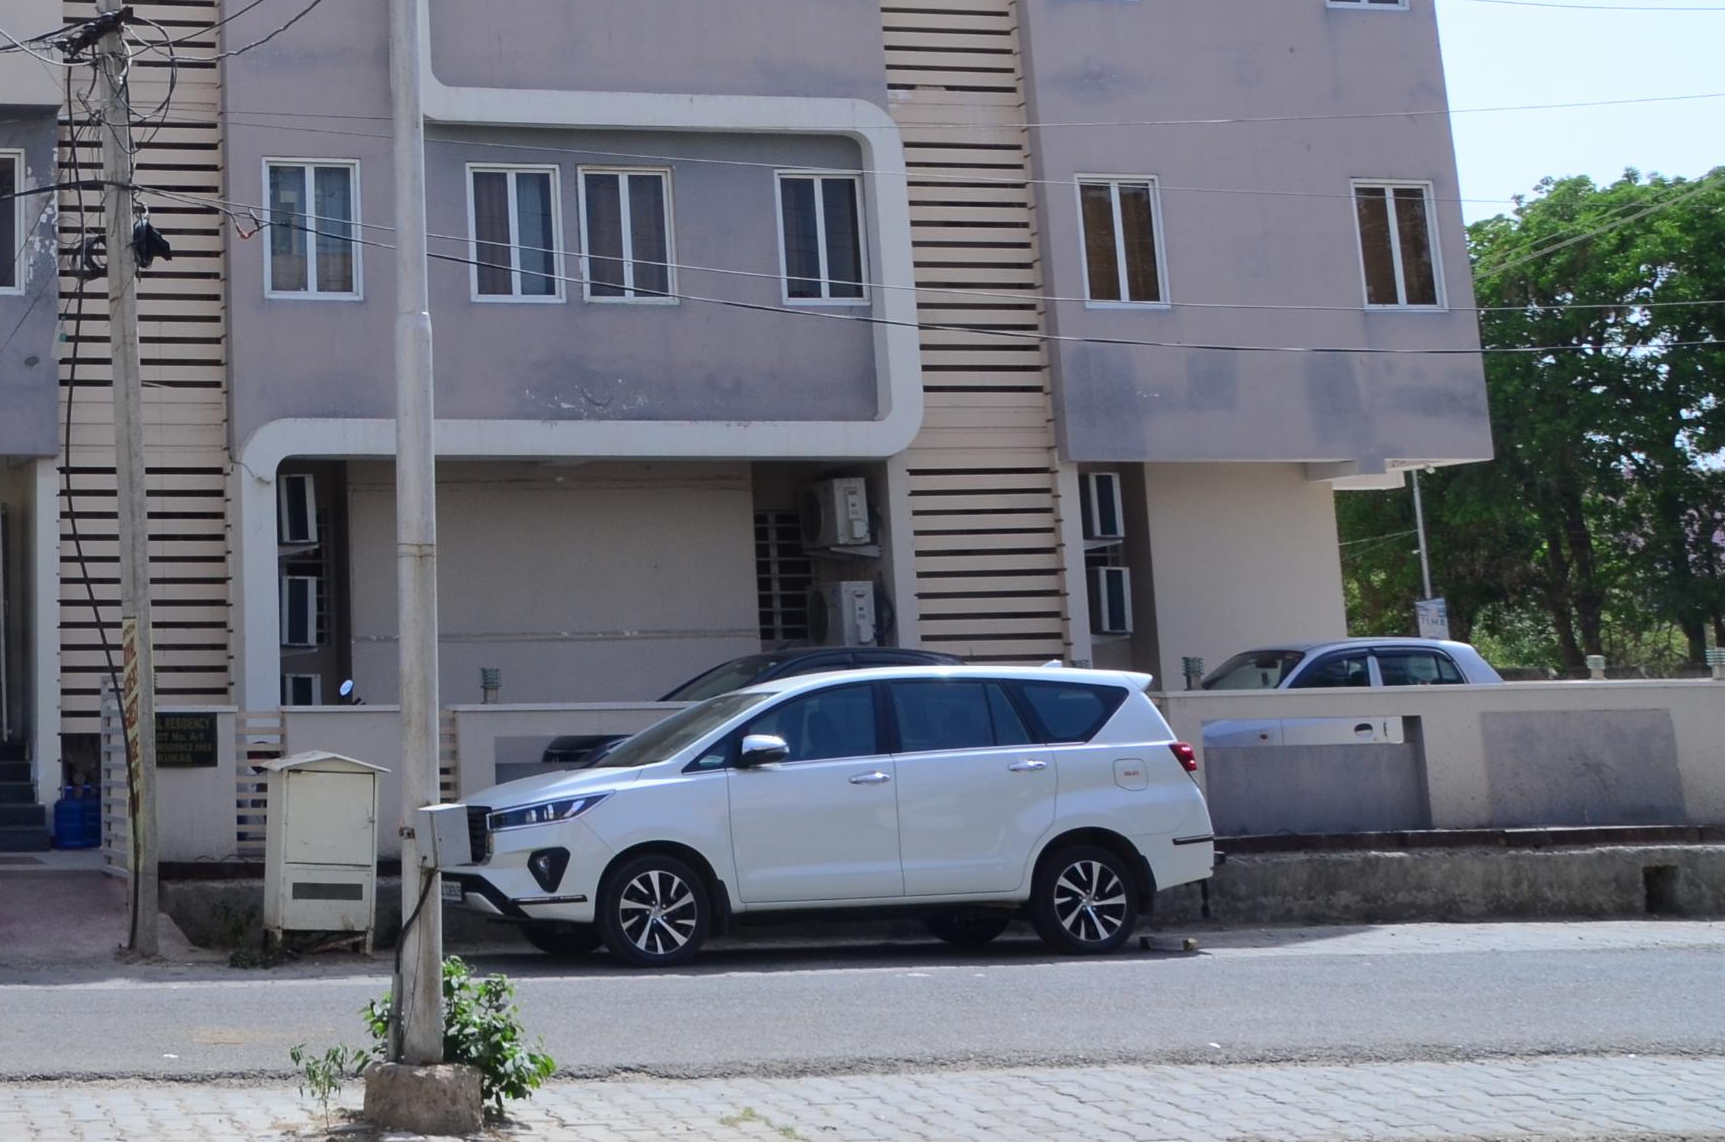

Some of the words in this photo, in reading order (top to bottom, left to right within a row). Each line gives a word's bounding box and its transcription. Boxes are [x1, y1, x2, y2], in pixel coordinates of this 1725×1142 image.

[1421, 617, 1445, 626] TIME
[165, 718, 210, 730] RESIDENCY
[156, 753, 192, 763] KUKAS
